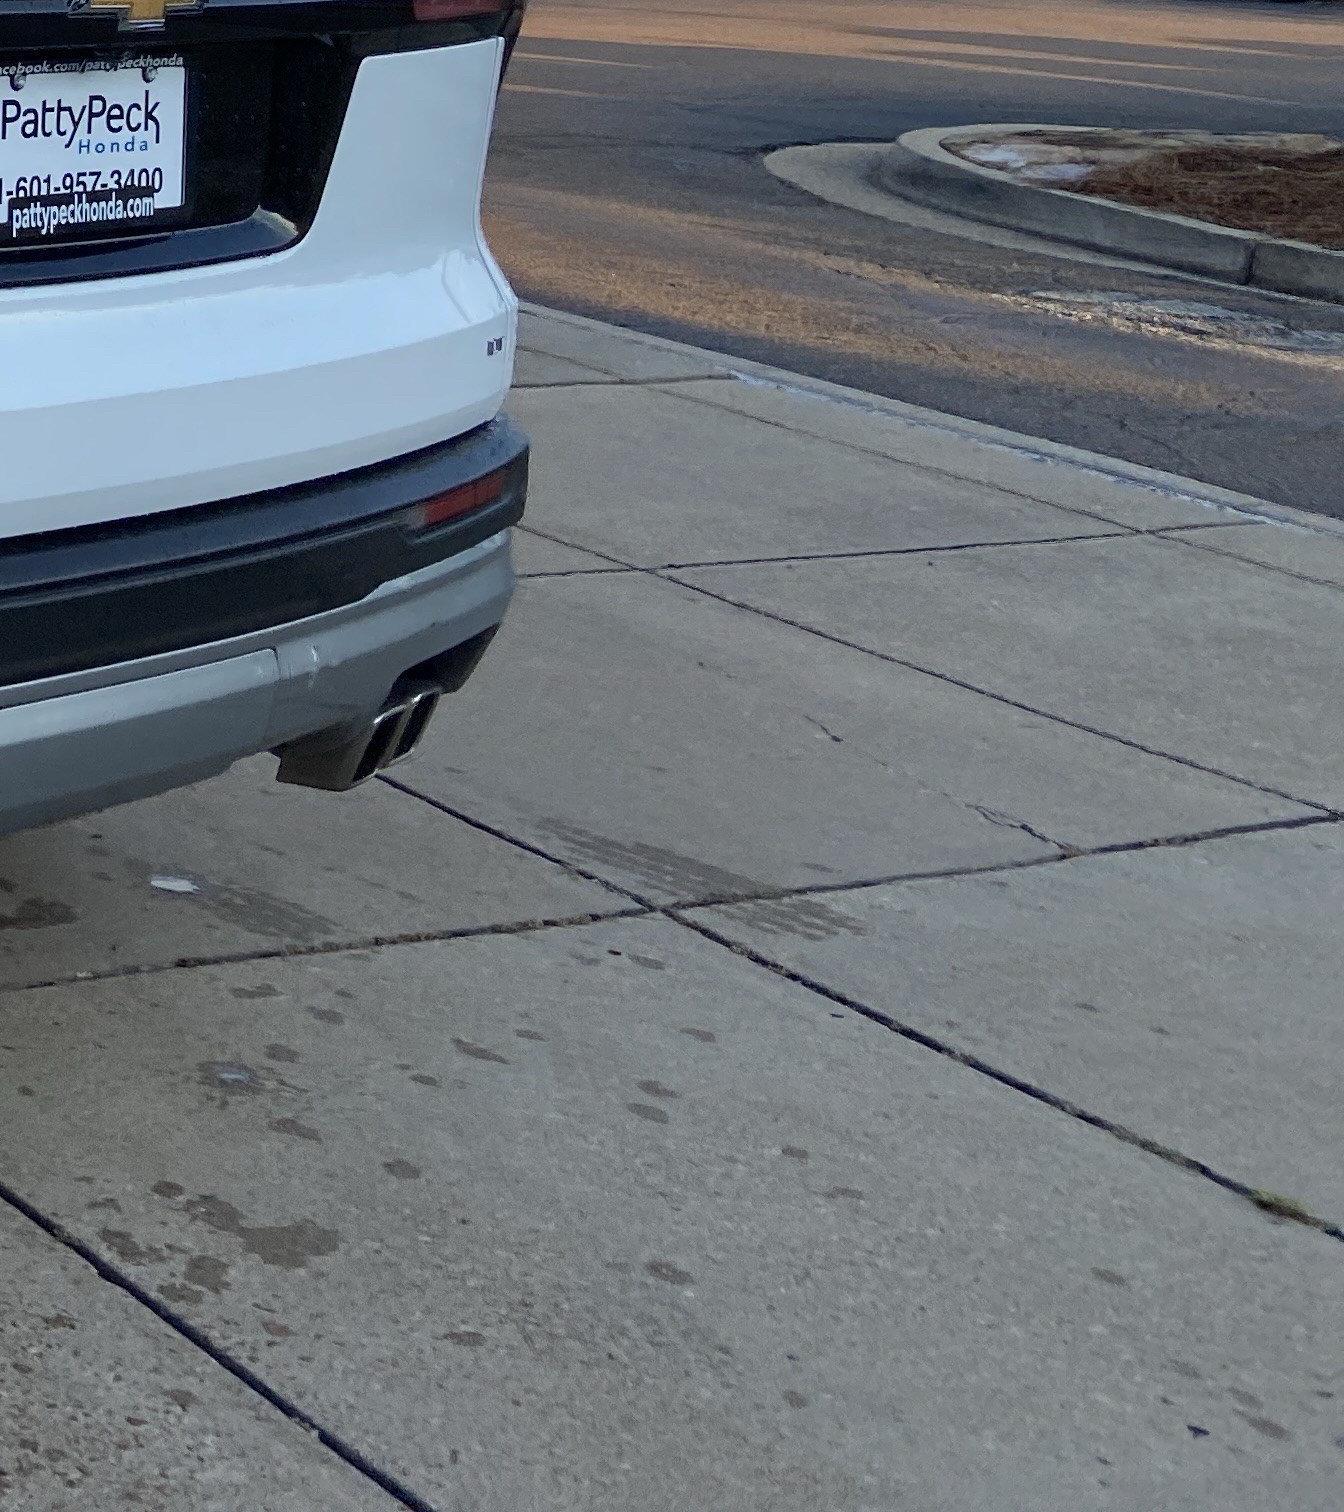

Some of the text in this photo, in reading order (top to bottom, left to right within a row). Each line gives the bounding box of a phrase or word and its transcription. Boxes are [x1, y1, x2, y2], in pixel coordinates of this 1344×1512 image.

[1, 90, 161, 149] PattyPeck
[78, 136, 149, 155] Honda
[12, 191, 155, 238] pattypeckhonda.com
